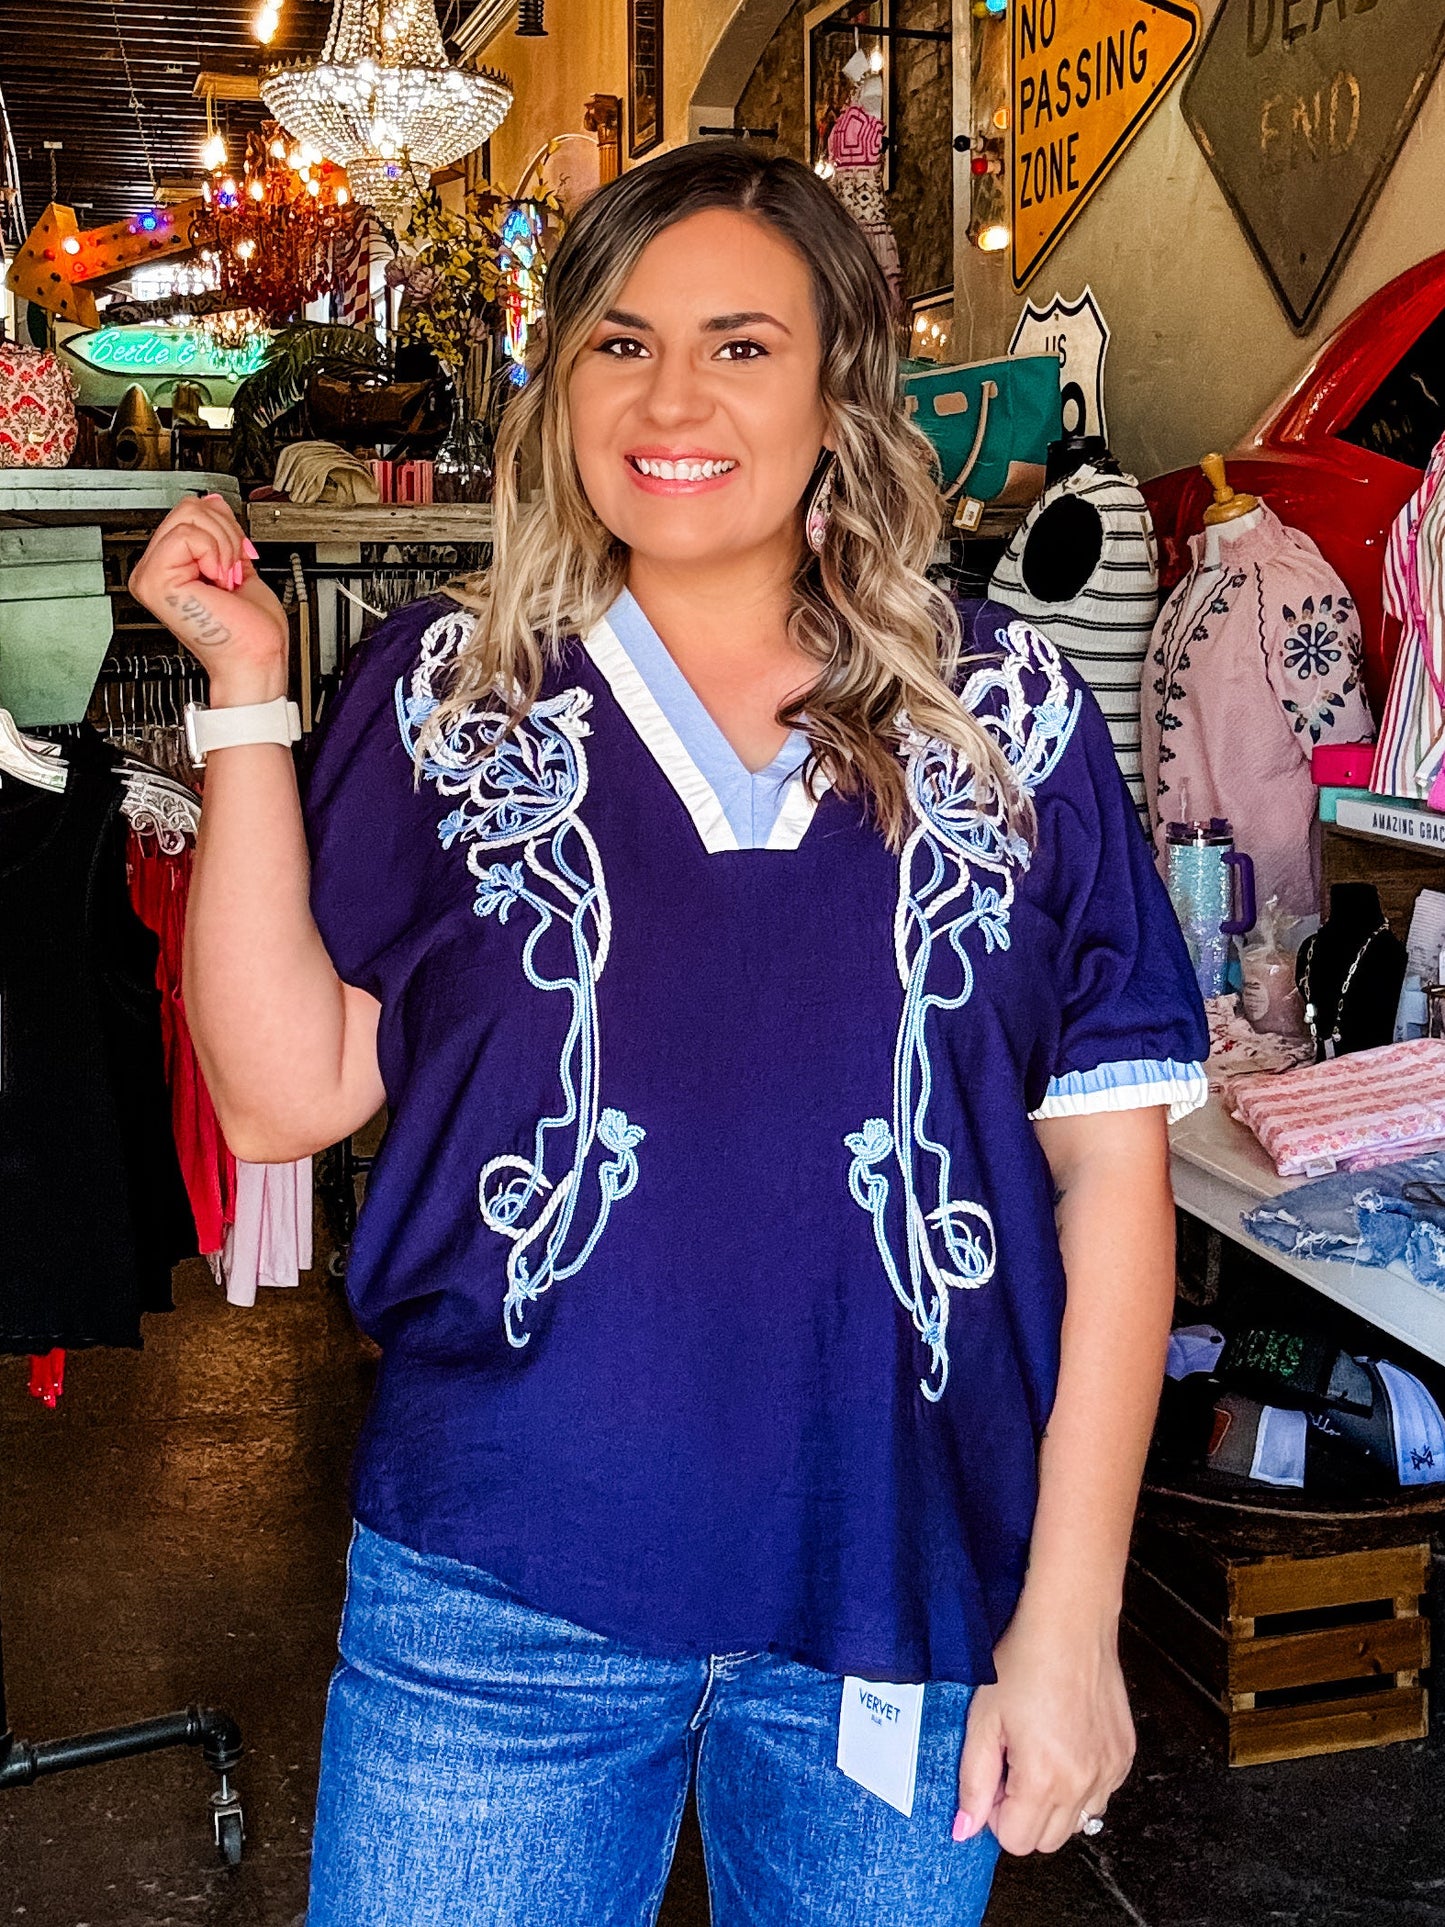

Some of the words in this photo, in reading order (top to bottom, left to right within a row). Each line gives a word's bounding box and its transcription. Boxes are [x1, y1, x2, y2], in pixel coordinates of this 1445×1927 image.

[1021, 0, 1056, 60] NO
[1020, 20, 1148, 136] PASSING
[1260, 70, 1361, 164] END
[1020, 131, 1079, 210] ZONE
[1372, 812, 1414, 836] AMAZING
[859, 1687, 901, 1724] VERVET
